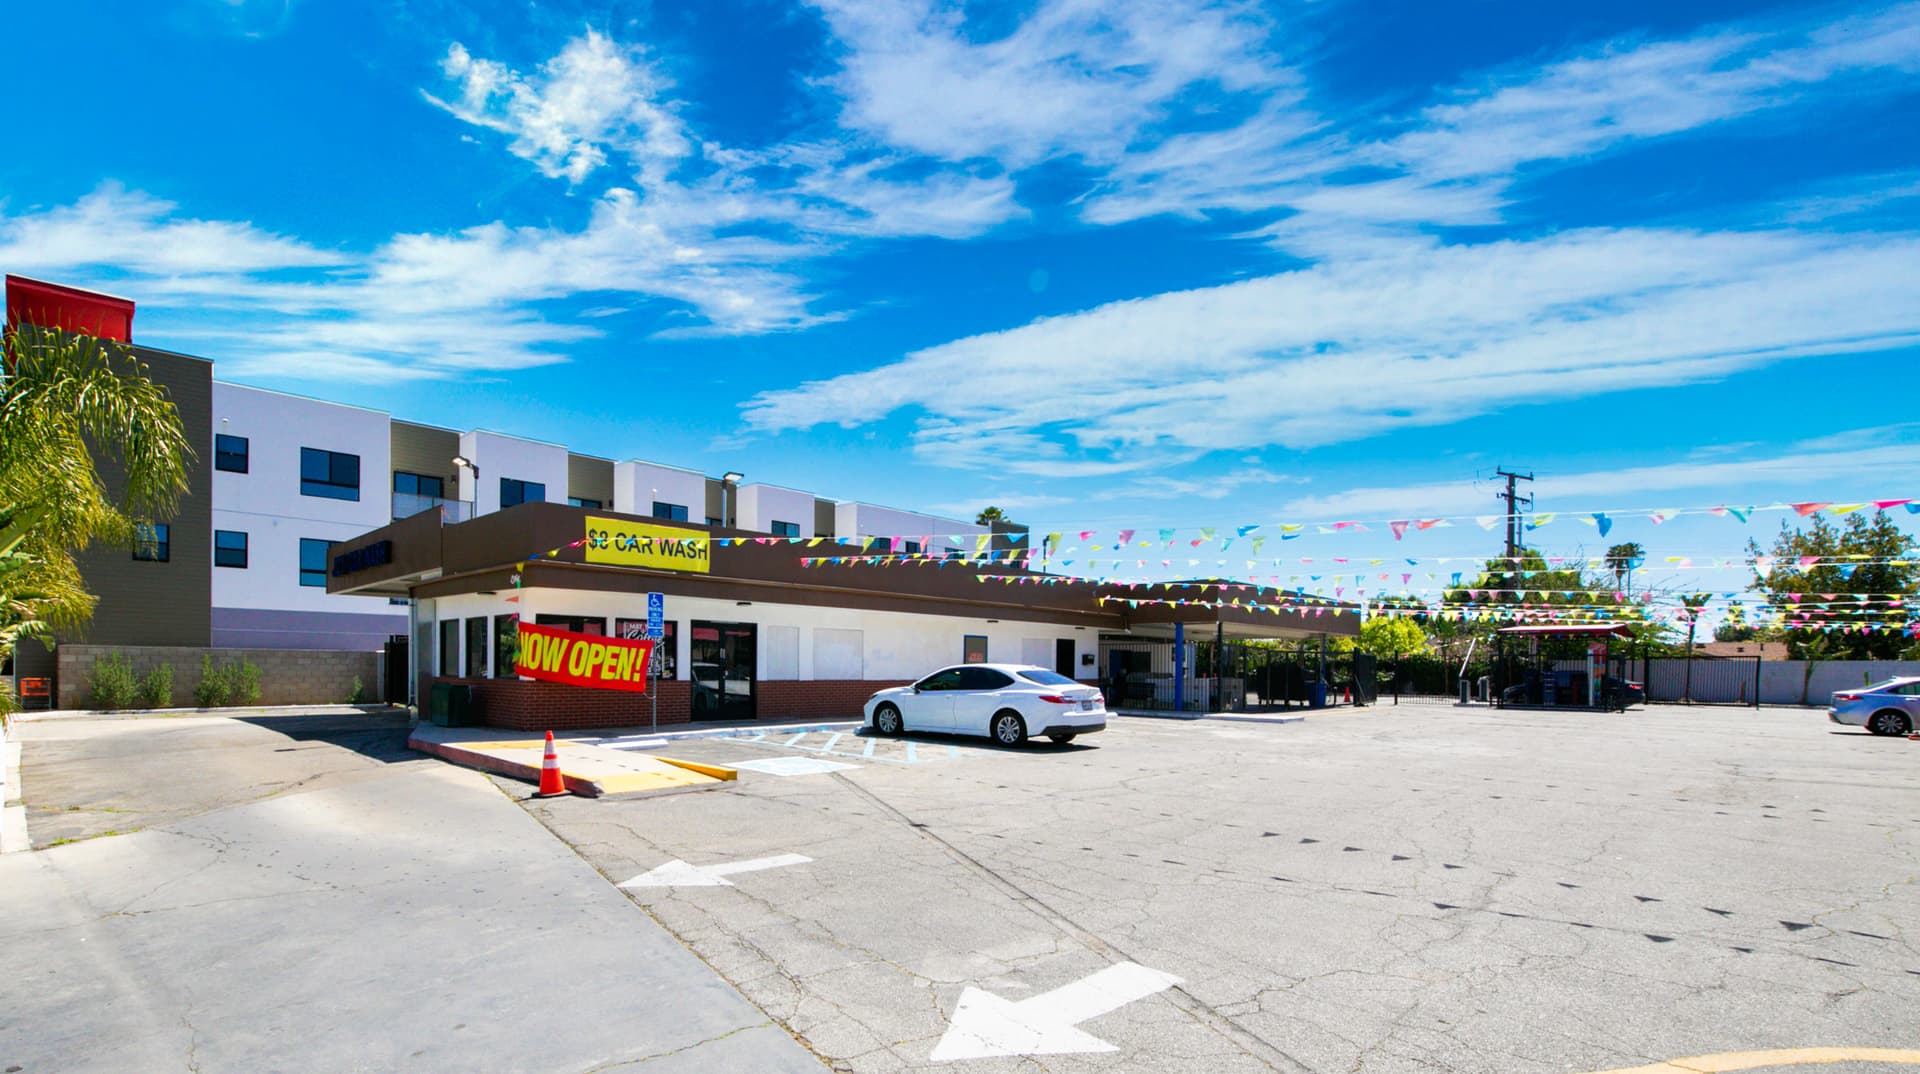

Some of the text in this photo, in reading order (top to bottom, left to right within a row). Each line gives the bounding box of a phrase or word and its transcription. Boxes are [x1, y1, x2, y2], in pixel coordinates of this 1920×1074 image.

[588, 528, 708, 561] $8 CAR WASH
[519, 631, 570, 673] NOW
[568, 640, 647, 683] OPEN!
